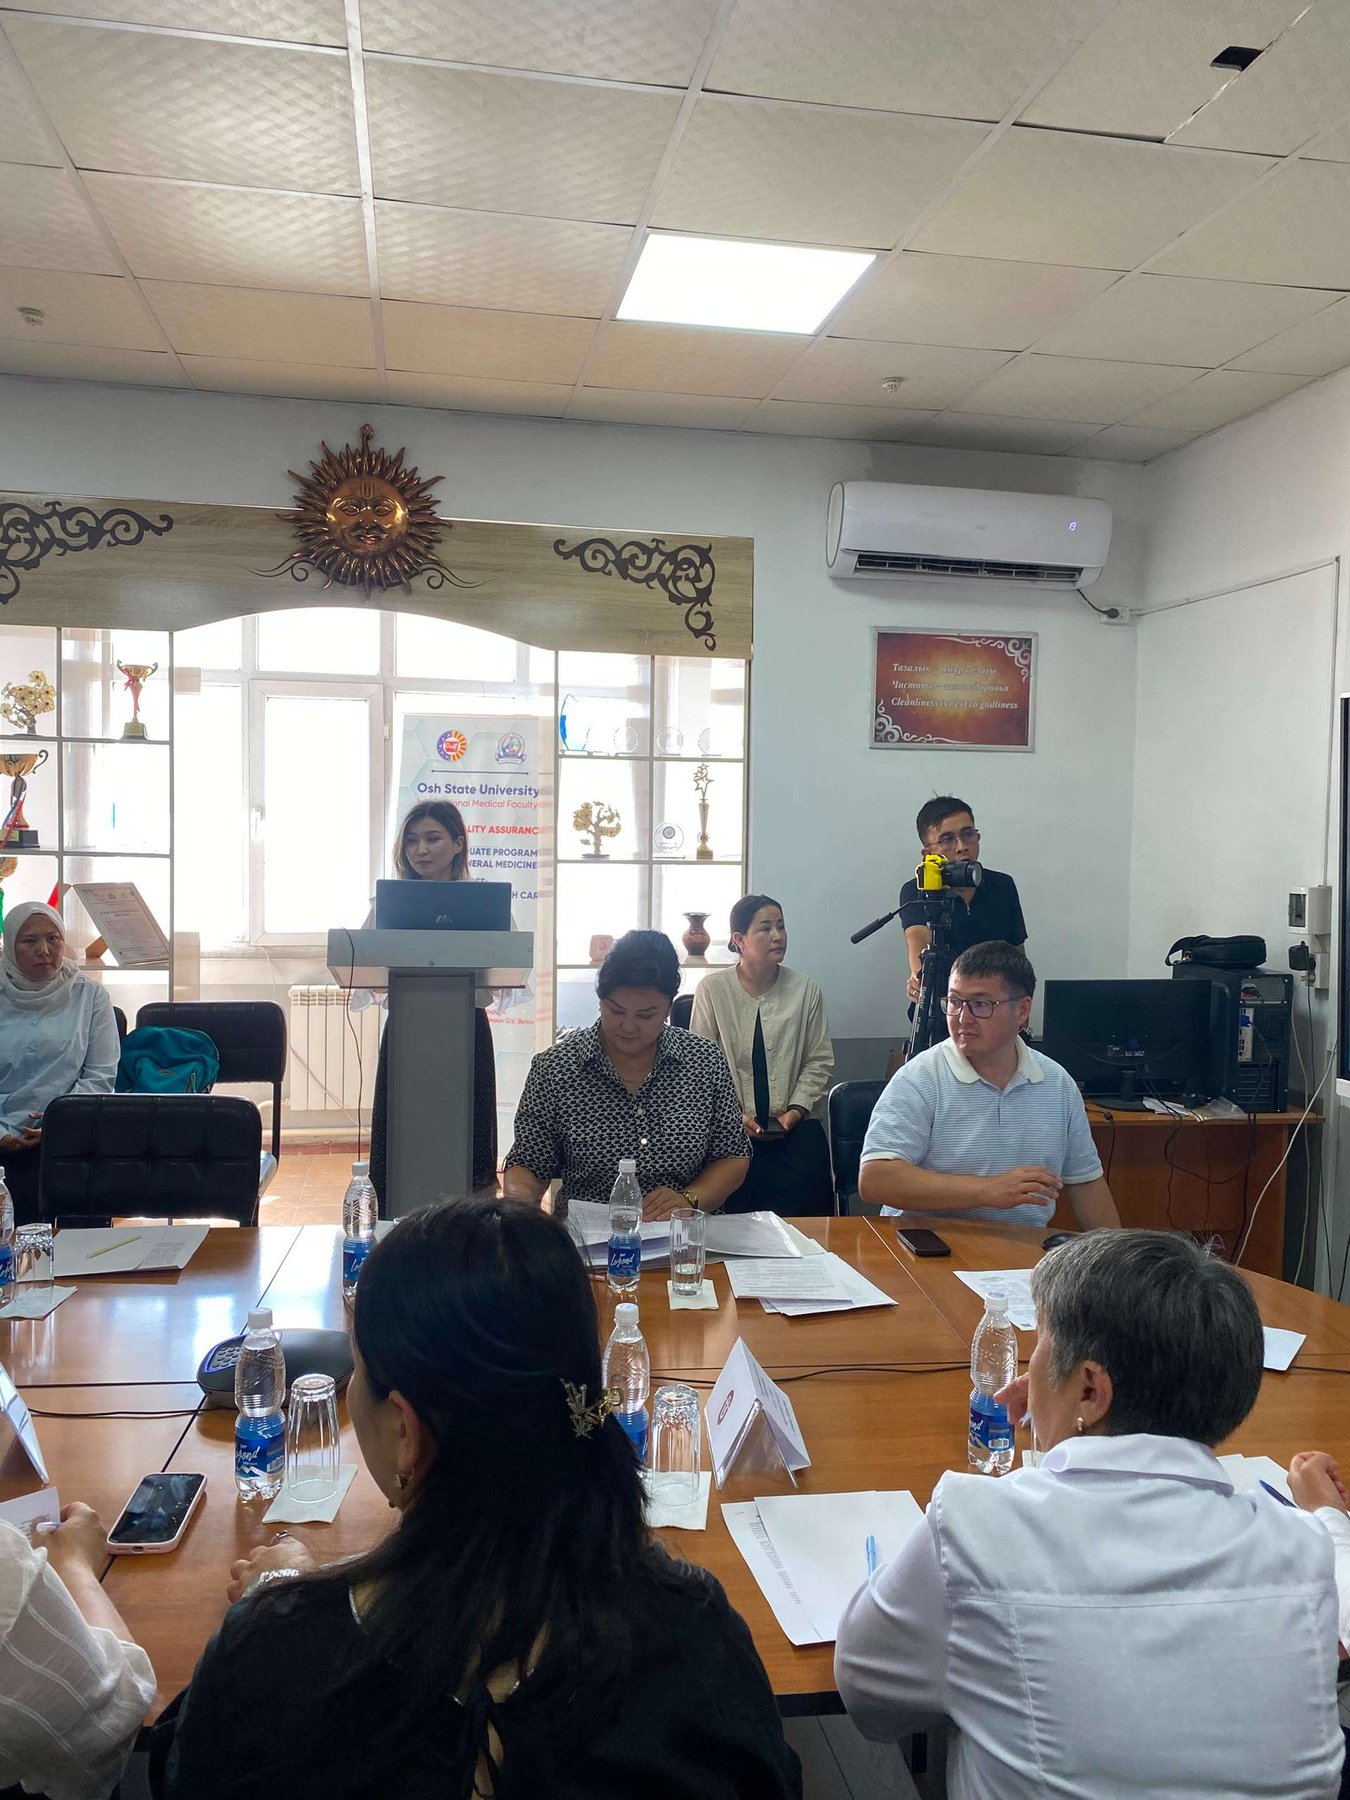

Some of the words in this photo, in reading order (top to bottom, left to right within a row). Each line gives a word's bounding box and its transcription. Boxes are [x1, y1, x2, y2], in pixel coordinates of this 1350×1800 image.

[892, 663, 931, 672] Тазалык
[891, 697, 938, 707] Cleanliness
[979, 700, 1019, 710] godliness
[417, 782, 441, 793] Osh
[444, 783, 477, 795] State
[479, 784, 539, 798] University
[472, 799, 505, 808] Medical
[507, 800, 538, 809] Faculty
[488, 826, 539, 834] ASSURANC
[495, 861, 538, 869] MEDICINE
